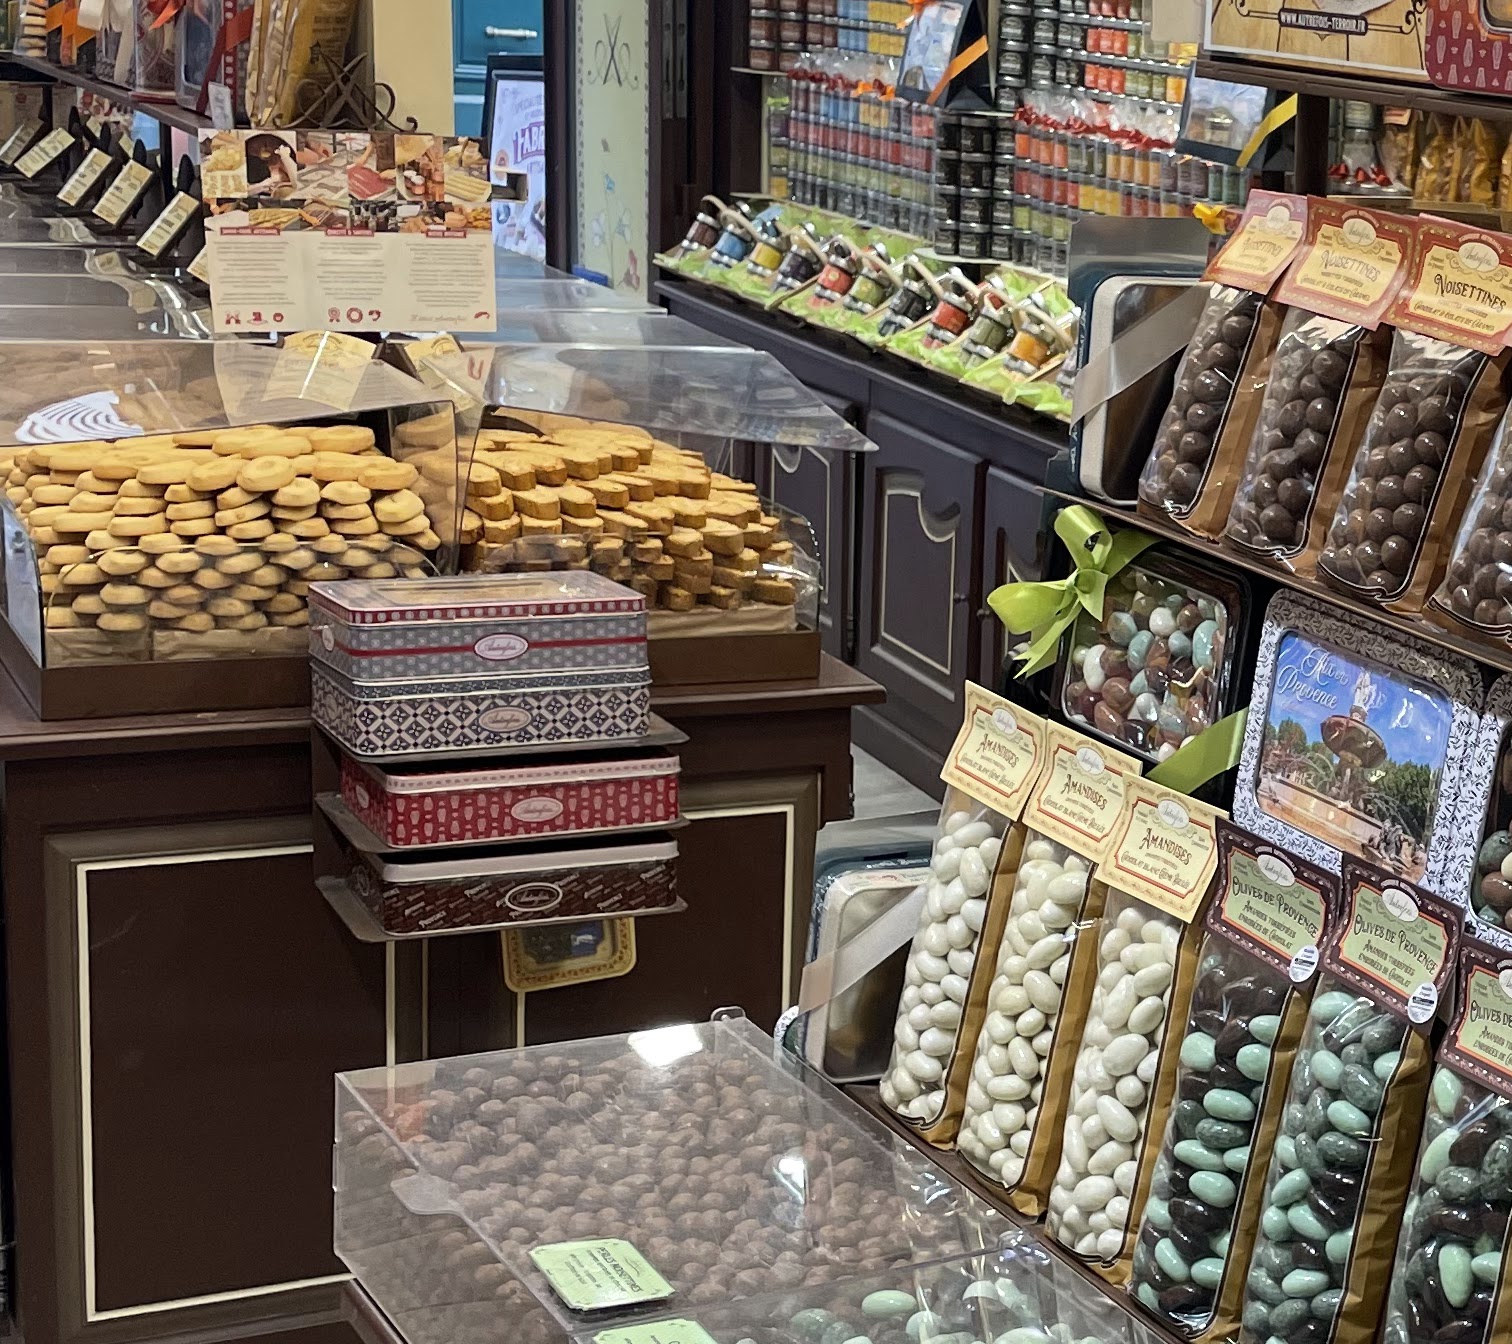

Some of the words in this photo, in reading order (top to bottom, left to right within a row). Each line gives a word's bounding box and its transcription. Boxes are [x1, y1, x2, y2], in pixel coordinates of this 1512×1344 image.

[1321, 249, 1381, 283] NOISETTINES
[1434, 272, 1507, 314] NOISETTINES
[1278, 664, 1338, 709] Provence
[1061, 773, 1108, 812] AMANDISES
[1139, 828, 1193, 866] AMANDISES
[1232, 876, 1262, 901] OLIVES
[1263, 891, 1276, 903] DE
[1276, 894, 1319, 940] PROVENCE
[1353, 913, 1385, 939] OLIVES
[1386, 929, 1397, 942] DE
[1398, 930, 1438, 975] PROVENCE
[1470, 1000, 1502, 1025] OLIVES
[1503, 1013, 1512, 1026] DE
